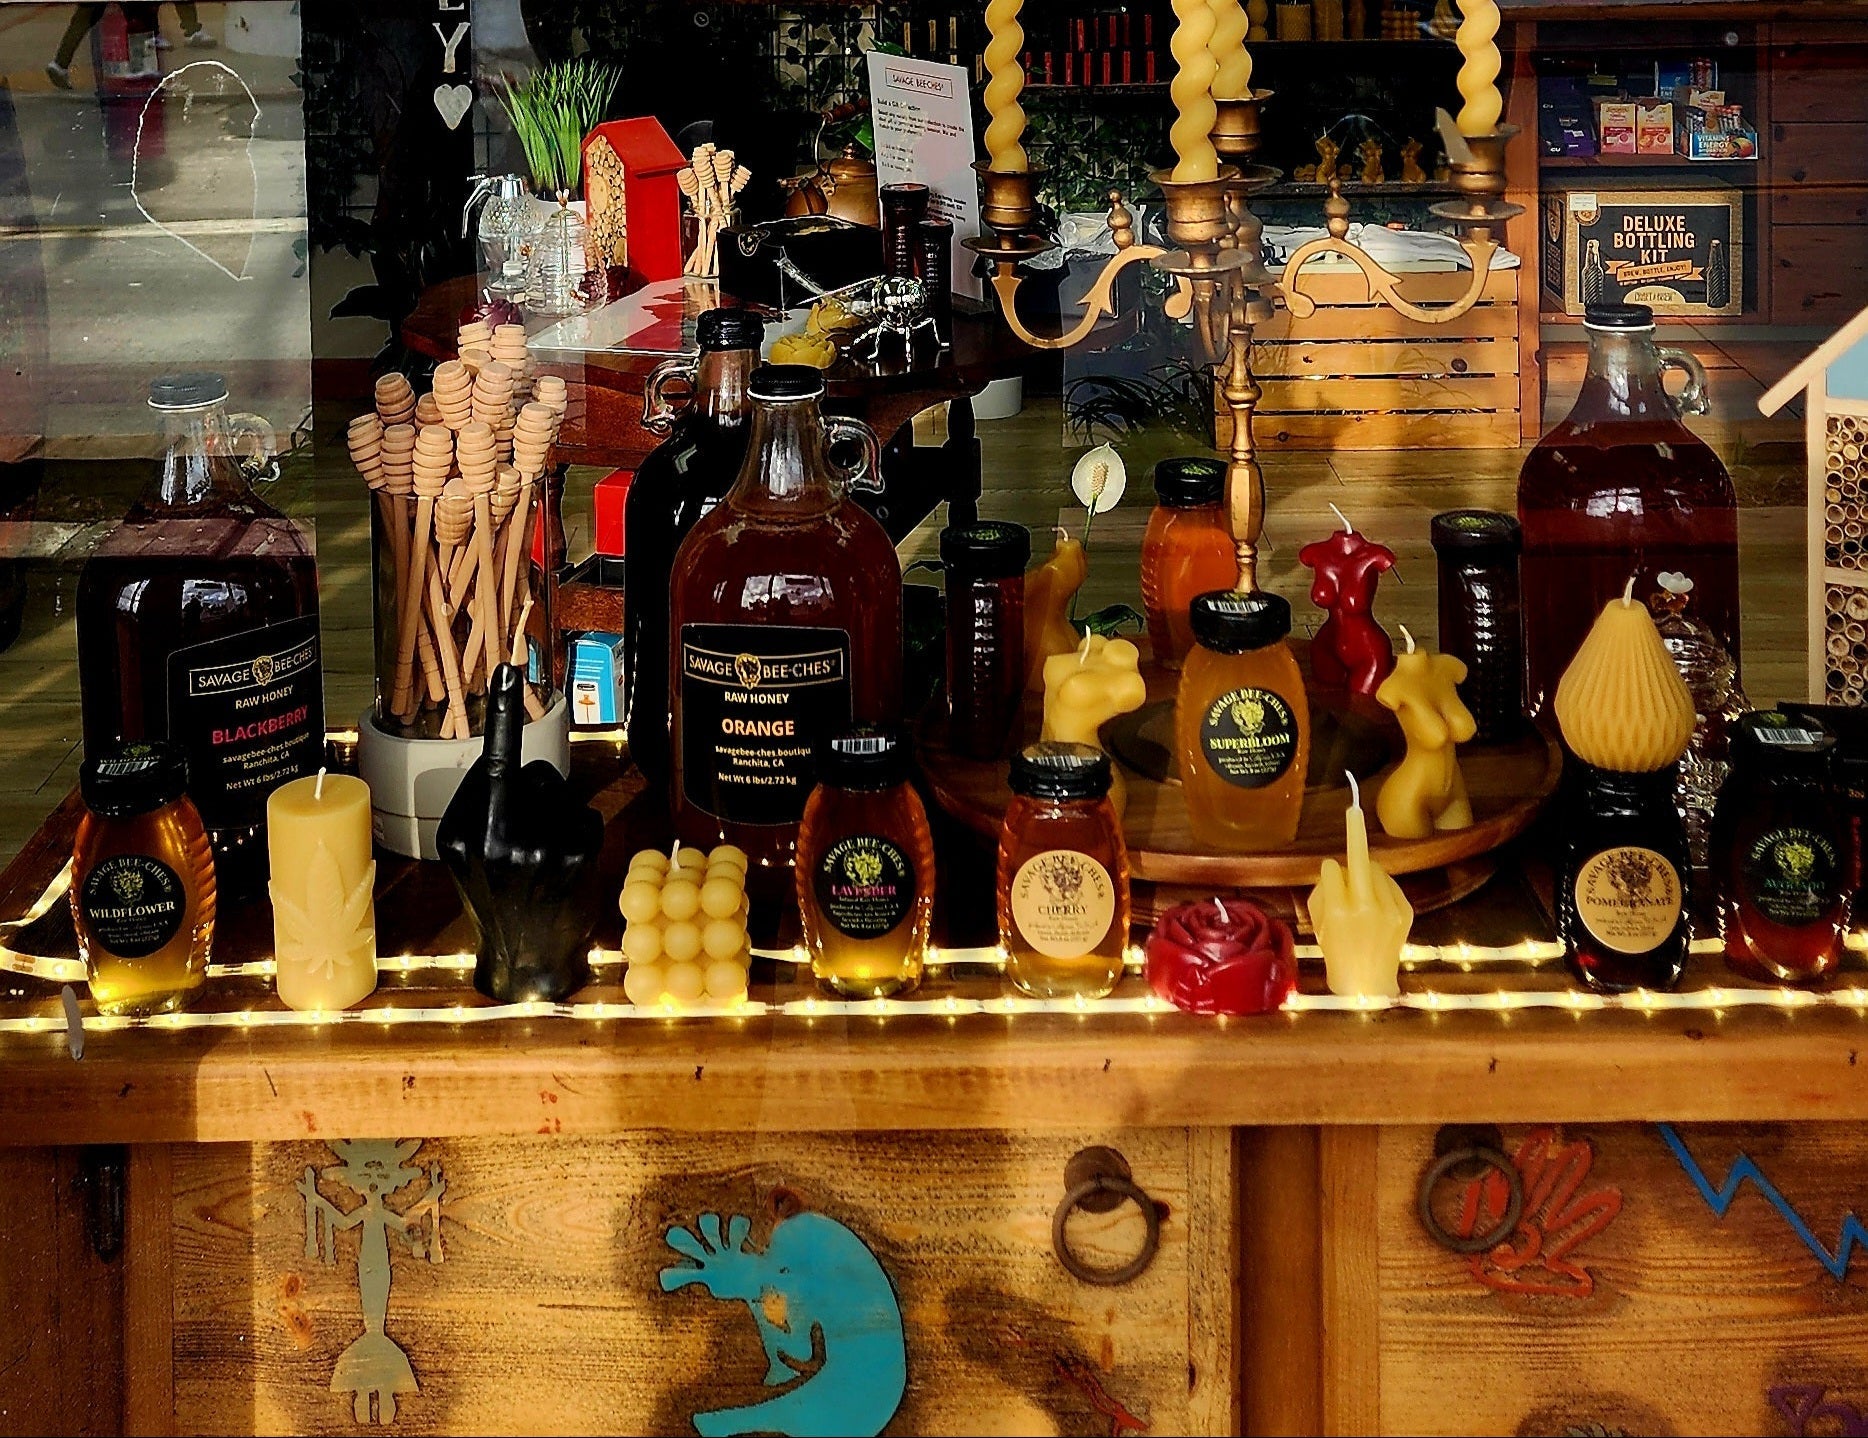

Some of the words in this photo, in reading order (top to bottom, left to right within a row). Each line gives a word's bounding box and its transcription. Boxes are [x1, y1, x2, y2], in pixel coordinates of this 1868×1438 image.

[432, 0, 471, 73] Y
[1623, 215, 1686, 232] DELUXE
[1613, 232, 1696, 249] BOTTLING
[1640, 249, 1669, 265] KIT
[689, 654, 733, 677] SAVAGE
[198, 668, 251, 688] SAVAGE
[235, 695, 260, 710] RAW
[261, 684, 294, 705] HONEY
[724, 691, 748, 704] RAW
[750, 693, 790, 705] HONEY
[1208, 692, 1240, 727] SAVAGE
[212, 705, 309, 745] BLACKBERRY
[721, 718, 795, 737] ORANGE
[1209, 732, 1290, 750] SUPERBLOOM
[243, 753, 280, 770] Ranchita,
[280, 750, 290, 760] CA
[733, 757, 771, 768] Ranchita,
[773, 758, 785, 768] CA
[226, 782, 242, 791] Net
[243, 778, 255, 788] Wt
[256, 775, 262, 784] 6
[290, 764, 299, 775] kg
[718, 772, 732, 783] Net
[733, 774, 744, 784] Wt
[745, 775, 751, 784] 6
[752, 775, 785, 785] lbs/2.72
[786, 775, 797, 786] kg
[1751, 829, 1785, 861] SAVAGE
[823, 839, 855, 873] SAVAGE
[89, 860, 116, 896] SAVAGE
[1021, 858, 1047, 899] SAVAGE
[1586, 854, 1615, 893] SAVAGE
[832, 884, 897, 896] LAVENDER
[89, 901, 175, 919] WILDFLOWER
[1037, 904, 1088, 915] CHERRY
[1585, 897, 1673, 908] POMEGRANATE
